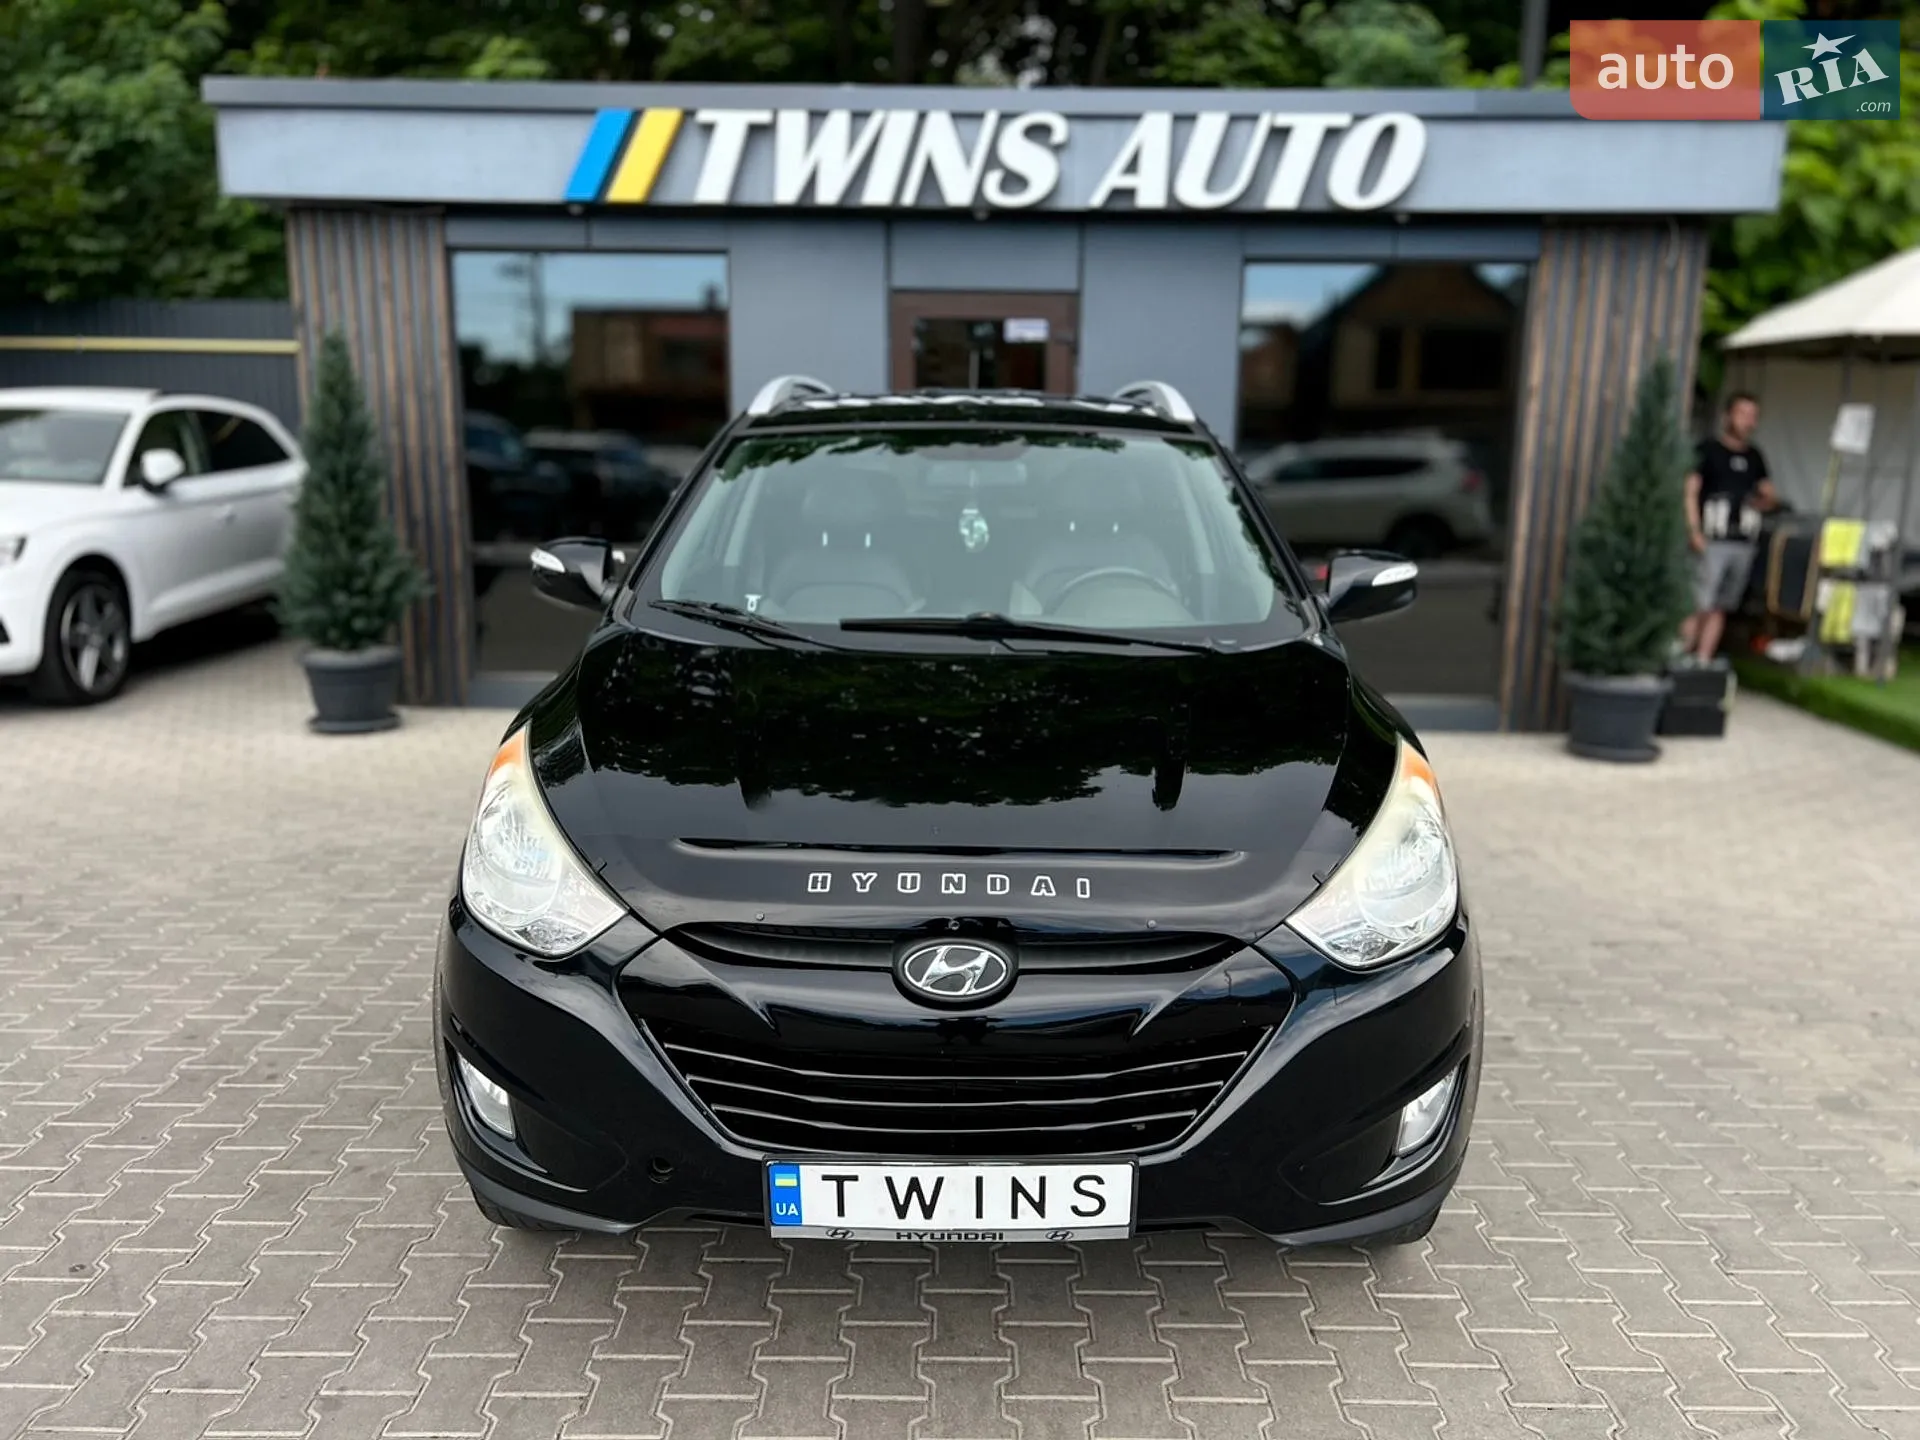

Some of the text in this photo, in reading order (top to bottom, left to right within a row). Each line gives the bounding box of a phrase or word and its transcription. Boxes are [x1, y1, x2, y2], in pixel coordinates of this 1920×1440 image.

[693, 108, 1428, 210] TWINS AUTO
[807, 872, 1091, 898] HYUNDAI
[775, 1201, 799, 1216] UA
[821, 1174, 1107, 1220] TWINS
[896, 1231, 1004, 1241] HYUNDAI
